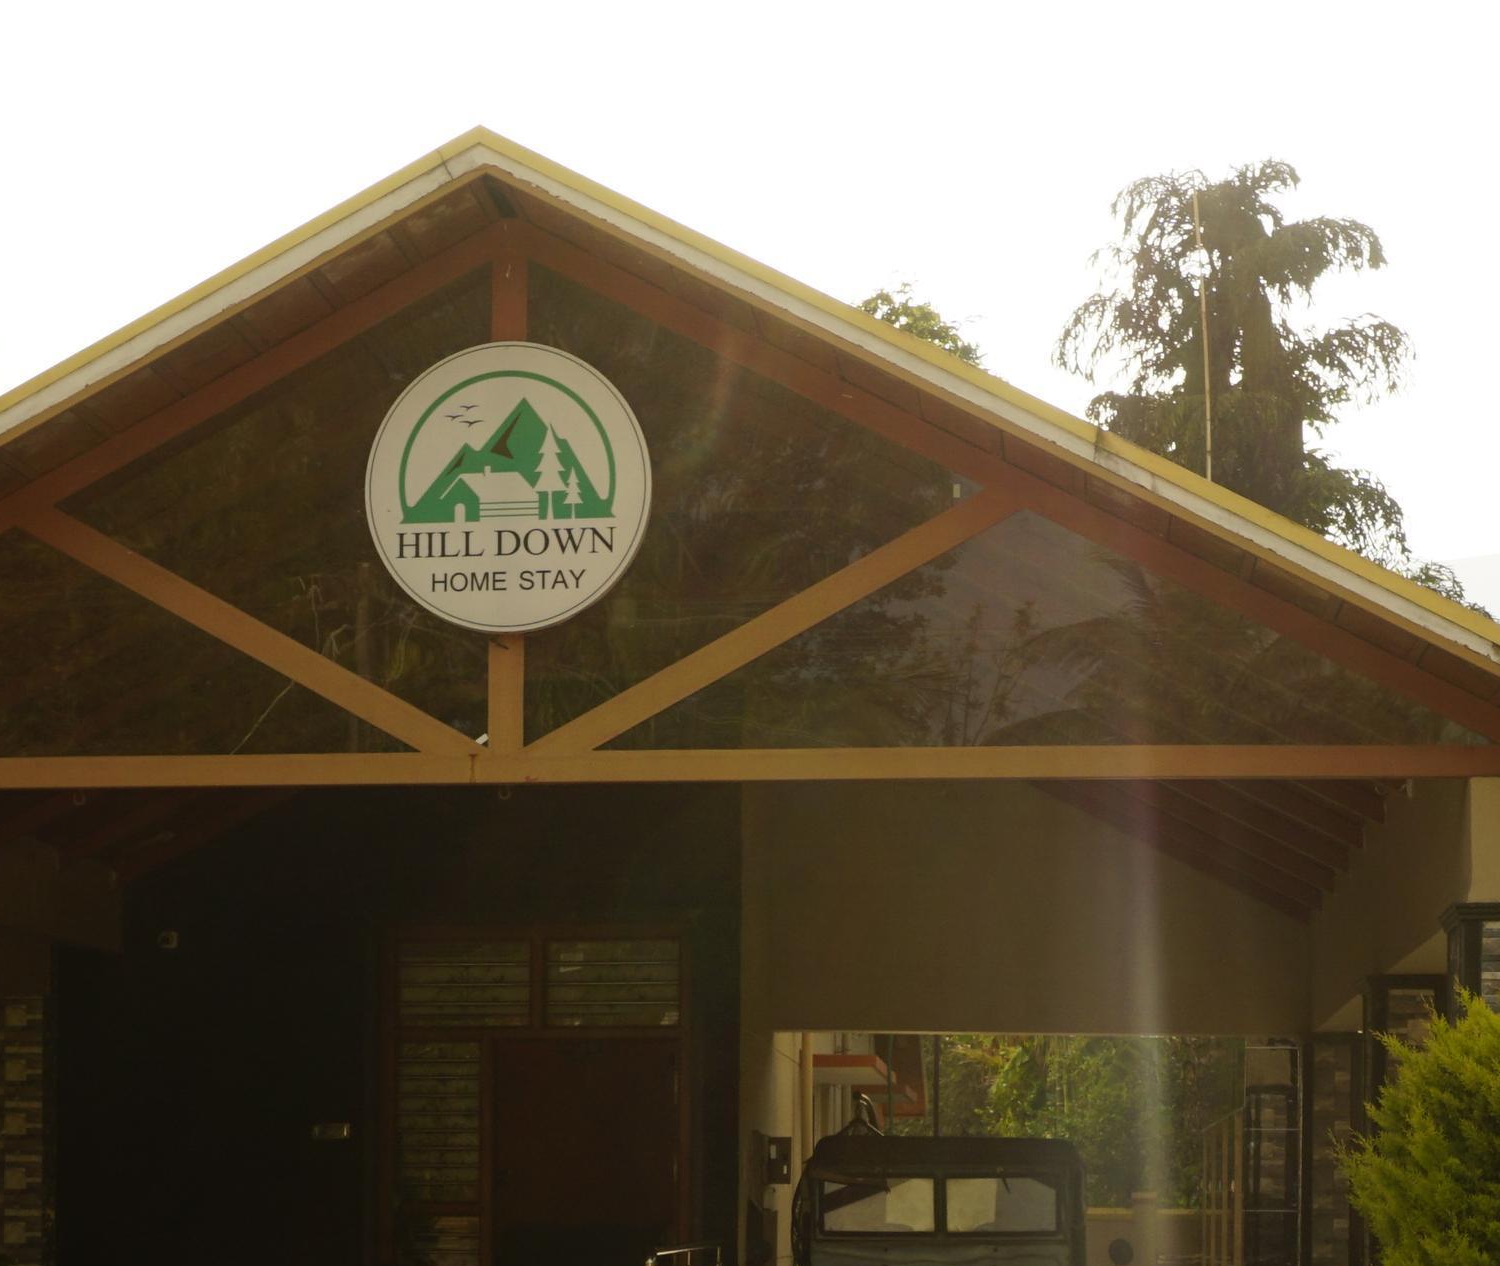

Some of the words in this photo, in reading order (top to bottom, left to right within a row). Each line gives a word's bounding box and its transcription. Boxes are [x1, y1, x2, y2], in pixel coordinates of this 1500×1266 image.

[396, 530, 485, 559] HILL
[494, 526, 617, 556] DOWN
[431, 571, 507, 592] HOME
[518, 568, 586, 590] STAY
